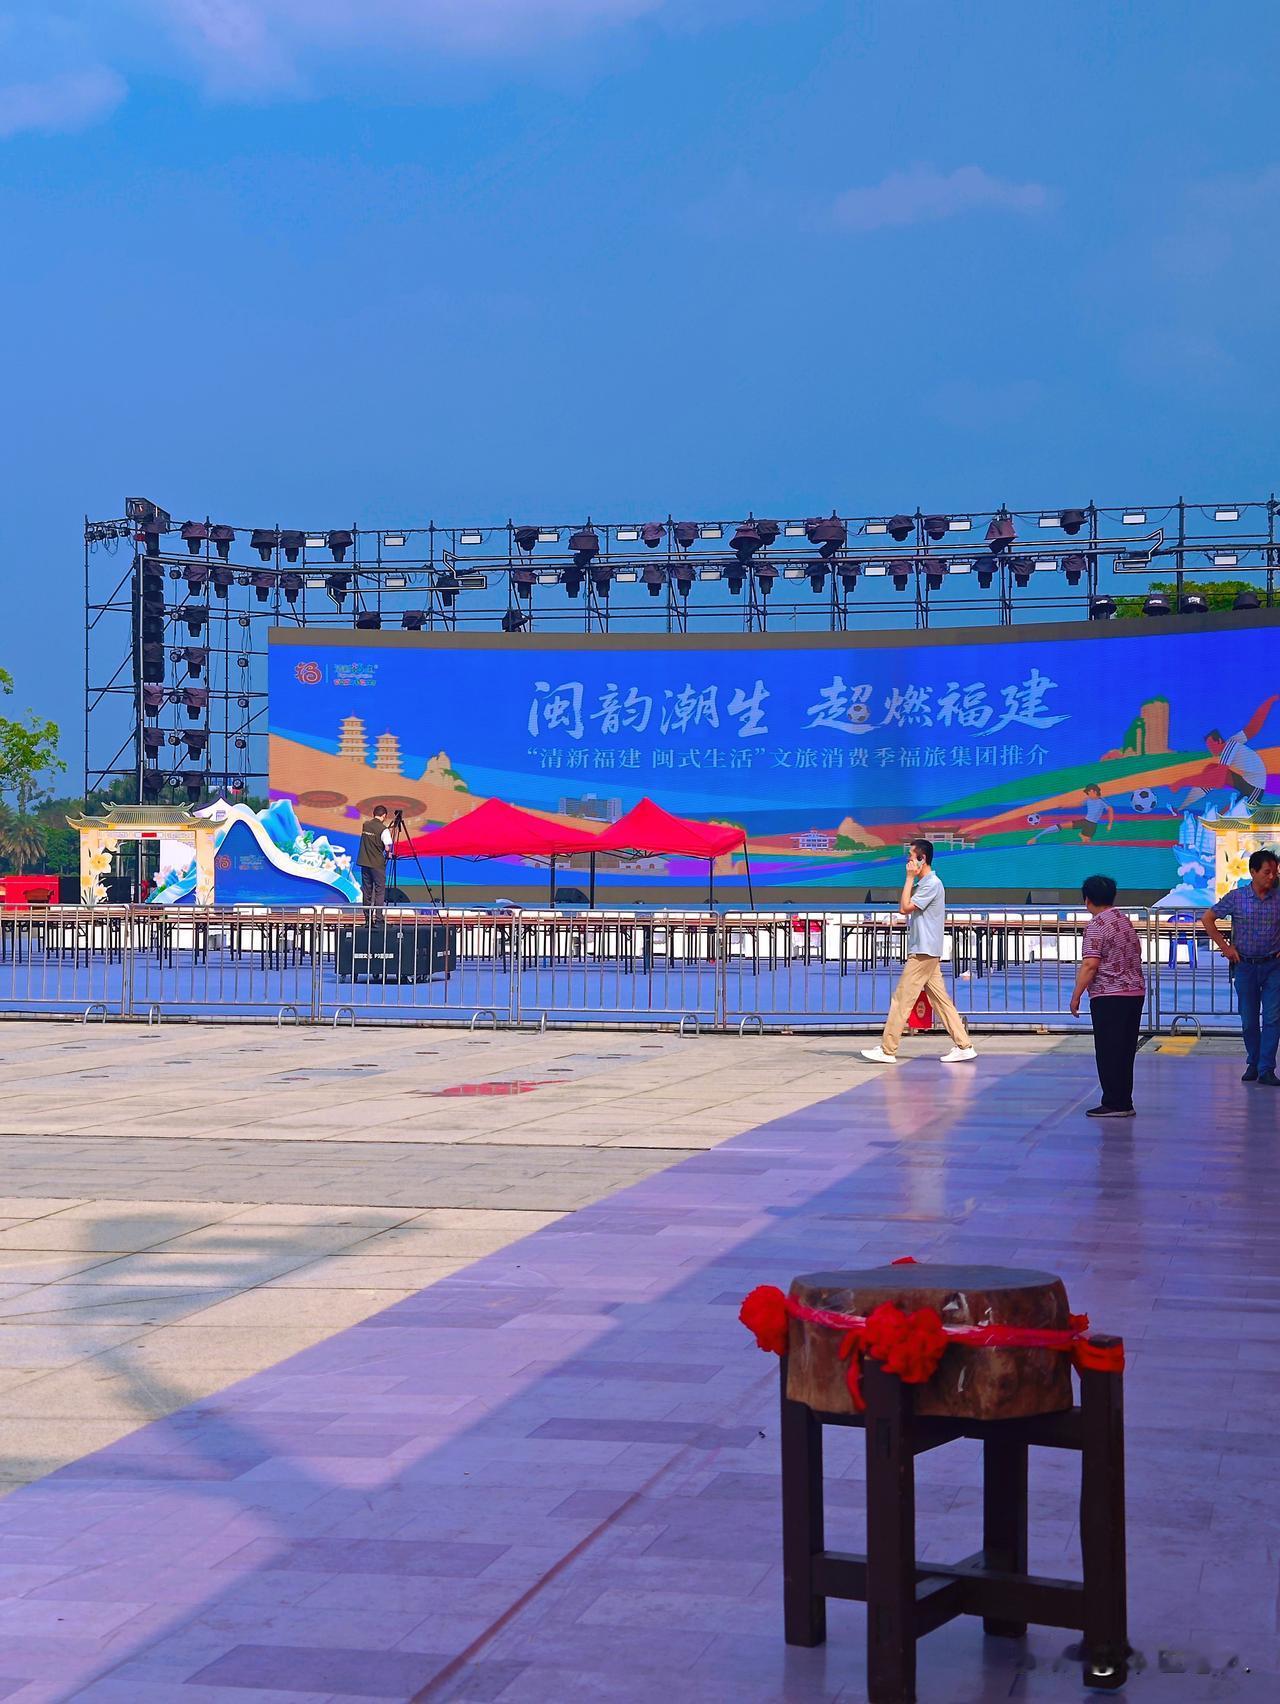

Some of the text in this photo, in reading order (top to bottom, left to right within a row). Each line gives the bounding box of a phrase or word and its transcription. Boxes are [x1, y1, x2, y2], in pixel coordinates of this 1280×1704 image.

[527, 668, 1073, 740] 闽韵潮生 超燃福建
[527, 747, 642, 769] “清新福建
